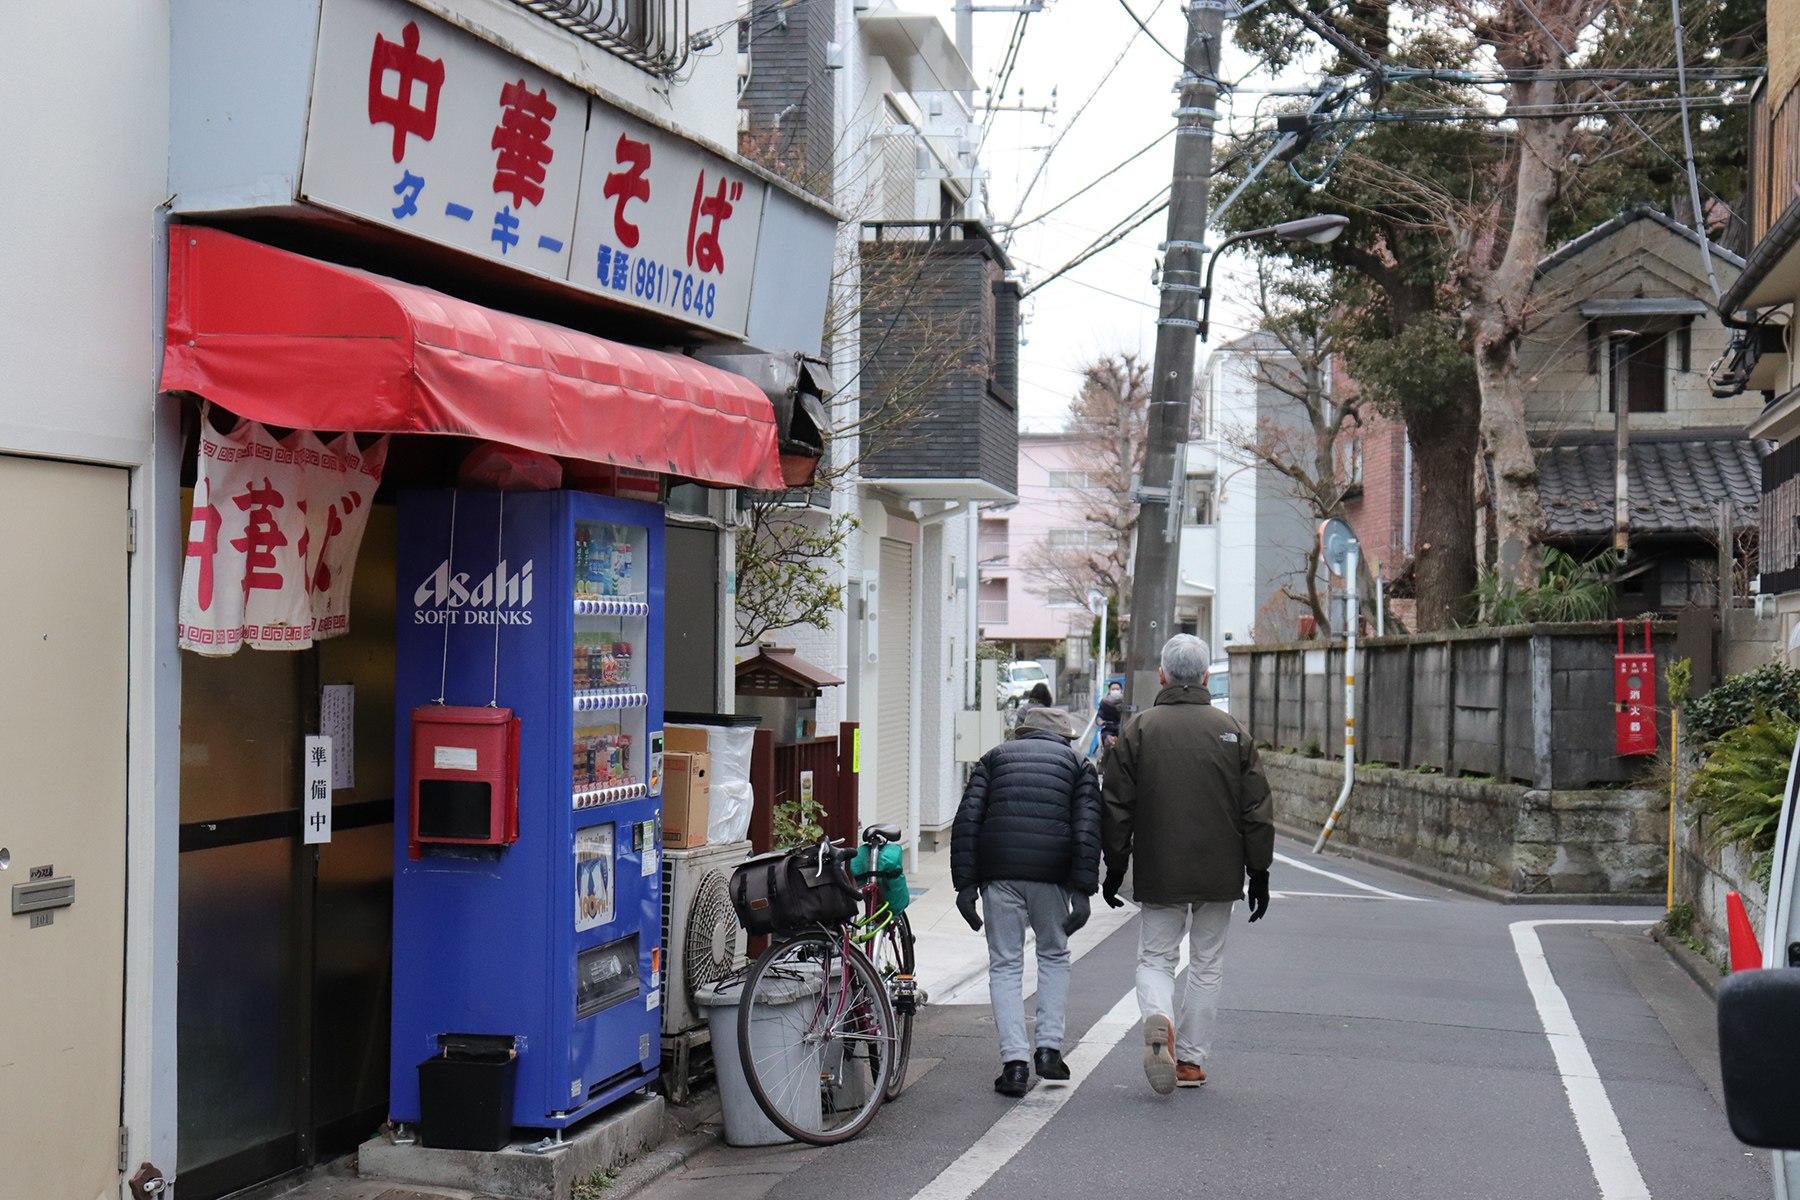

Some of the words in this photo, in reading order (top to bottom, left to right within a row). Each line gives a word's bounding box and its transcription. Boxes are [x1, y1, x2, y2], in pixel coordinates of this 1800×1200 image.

[368, 20, 743, 275] 中華そば
[392, 169, 563, 255] ターキー
[414, 559, 532, 607] Asahi
[414, 610, 459, 625] SOFT
[464, 610, 532, 625] DRINKS
[311, 747, 326, 832] 準備中
